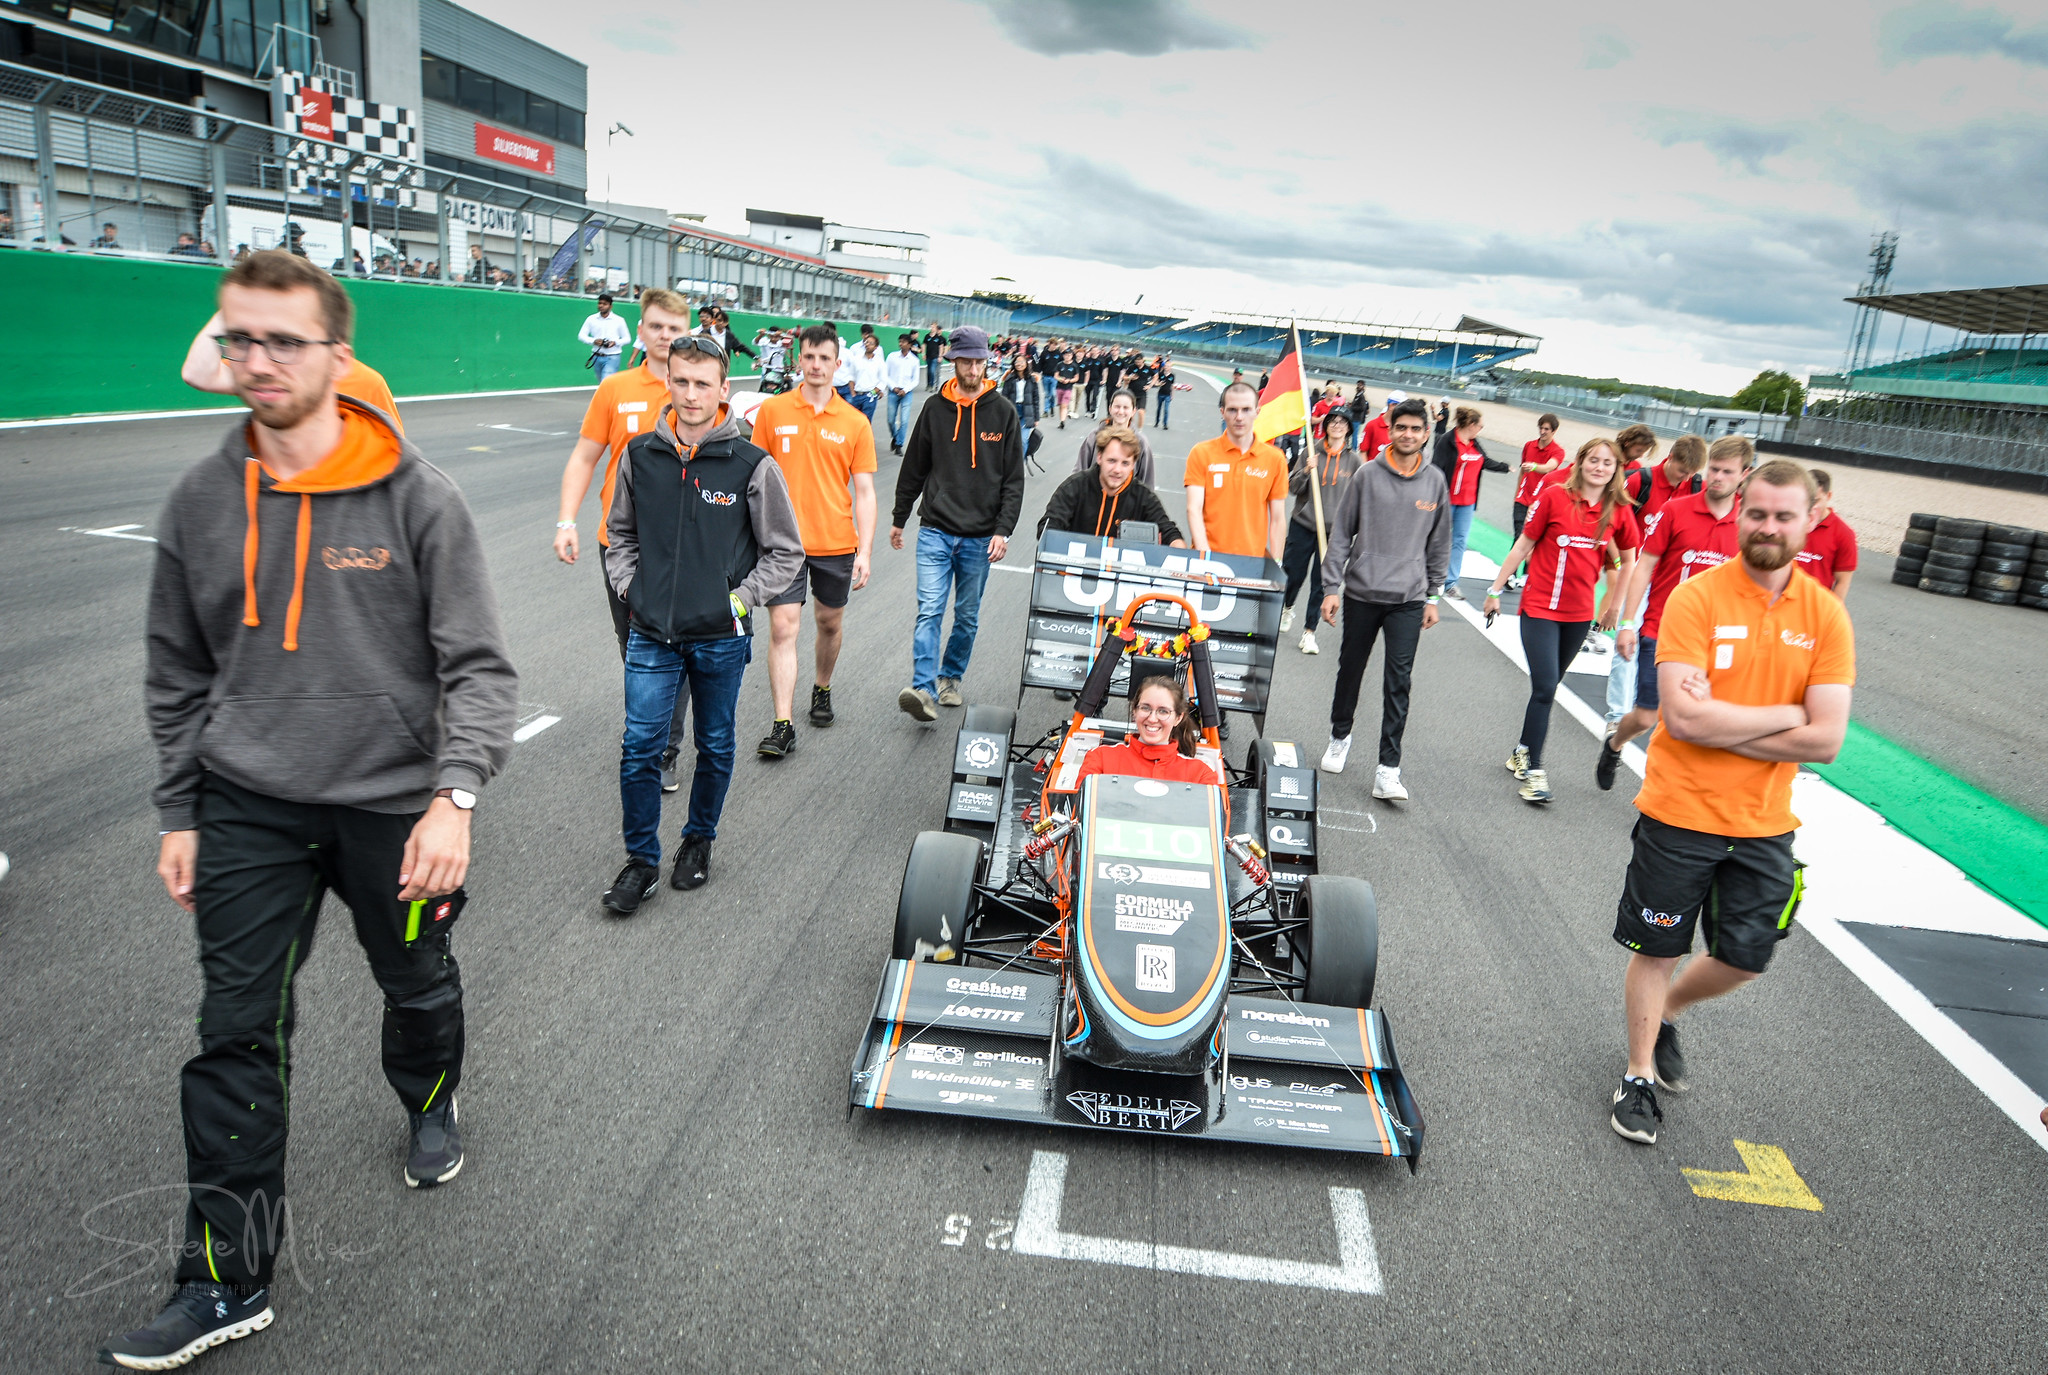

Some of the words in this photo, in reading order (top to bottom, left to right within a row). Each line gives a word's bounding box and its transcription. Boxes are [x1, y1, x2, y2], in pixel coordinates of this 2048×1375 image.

[493, 136, 539, 162] SILVERSTONE
[1063, 541, 1237, 622] UMD
[958, 790, 994, 802] PACK
[1103, 823, 1202, 859] 110
[1114, 903, 1192, 921] STUDENT
[1115, 893, 1195, 912] FORMULA
[942, 1004, 1025, 1023] LOCTITE
[1241, 1009, 1330, 1028] norelem
[911, 1069, 1011, 1088] Weidmüller
[1098, 1092, 1169, 1111] EDEL
[1247, 1096, 1294, 1108] TRACO
[1295, 1101, 1343, 1112] POWER
[1097, 1110, 1170, 1130] BERT
